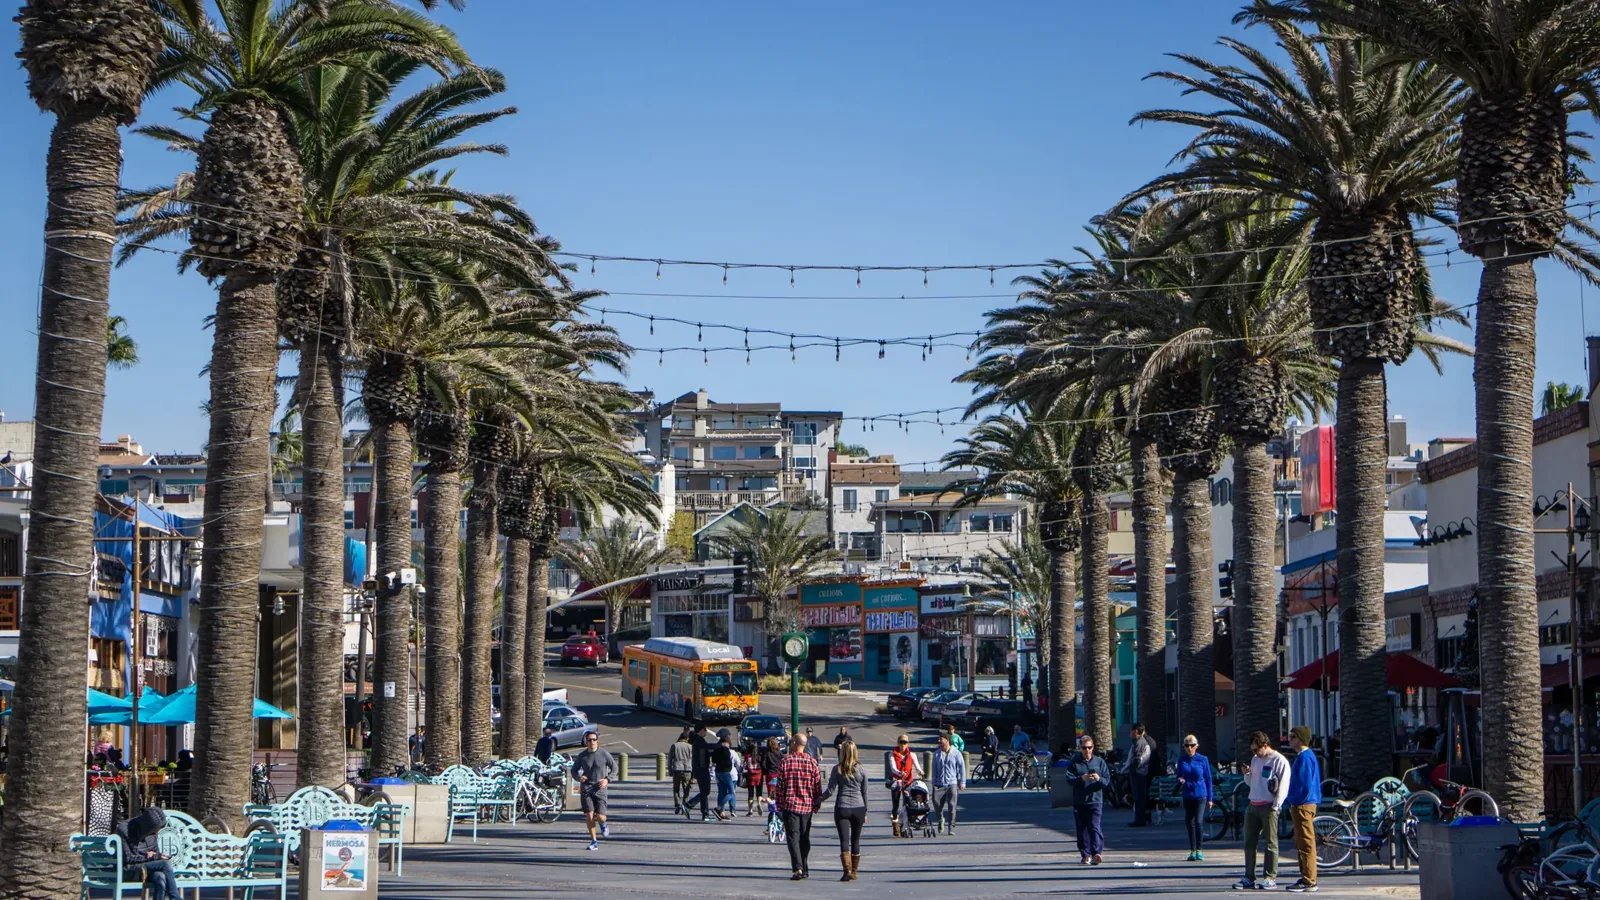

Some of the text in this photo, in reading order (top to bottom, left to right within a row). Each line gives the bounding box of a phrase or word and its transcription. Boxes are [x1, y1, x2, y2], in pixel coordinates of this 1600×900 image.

[658, 578, 691, 590] MAISON
[818, 588, 843, 598] curious
[706, 646, 731, 654] Local
